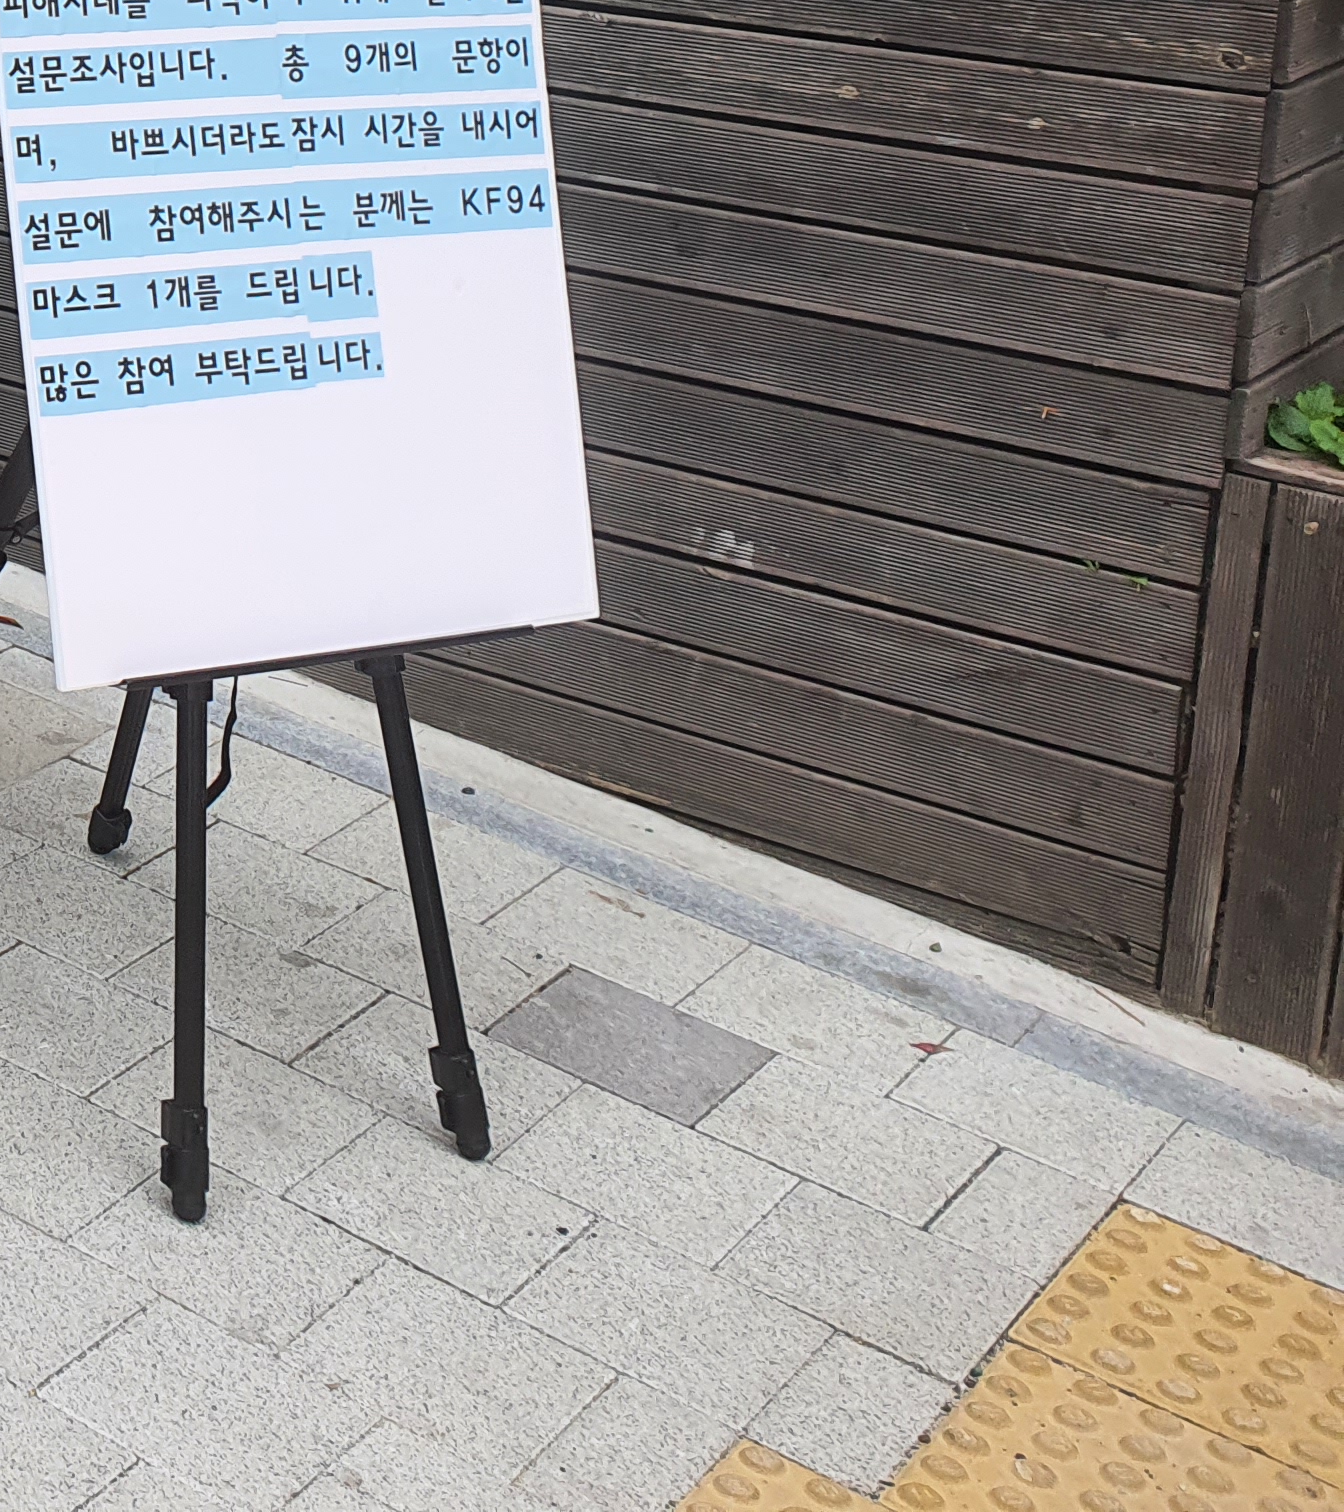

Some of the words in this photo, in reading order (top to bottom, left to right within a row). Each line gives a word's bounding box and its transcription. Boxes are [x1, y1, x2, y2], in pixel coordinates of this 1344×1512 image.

[8, 48, 228, 94] 설문조사입니다.
[282, 44, 310, 83] 총
[344, 41, 418, 73] 9개의
[452, 37, 529, 74] 문항이
[16, 134, 56, 172] 며,
[111, 122, 286, 160] 바쁘시더라도
[291, 115, 345, 153] 잠시
[364, 111, 445, 148] 시간을
[461, 108, 538, 141] 내시어
[24, 209, 112, 251] 설문에
[148, 195, 326, 243] 참여해주시는
[353, 190, 434, 228] 분께는
[461, 184, 546, 216] KF94
[32, 283, 121, 319] 마스크
[146, 274, 223, 312] 1개를
[246, 264, 374, 305] 드립니다.
[39, 360, 100, 403] 많은
[117, 354, 175, 396] 참여
[195, 339, 382, 386] 부탁드립니다.
